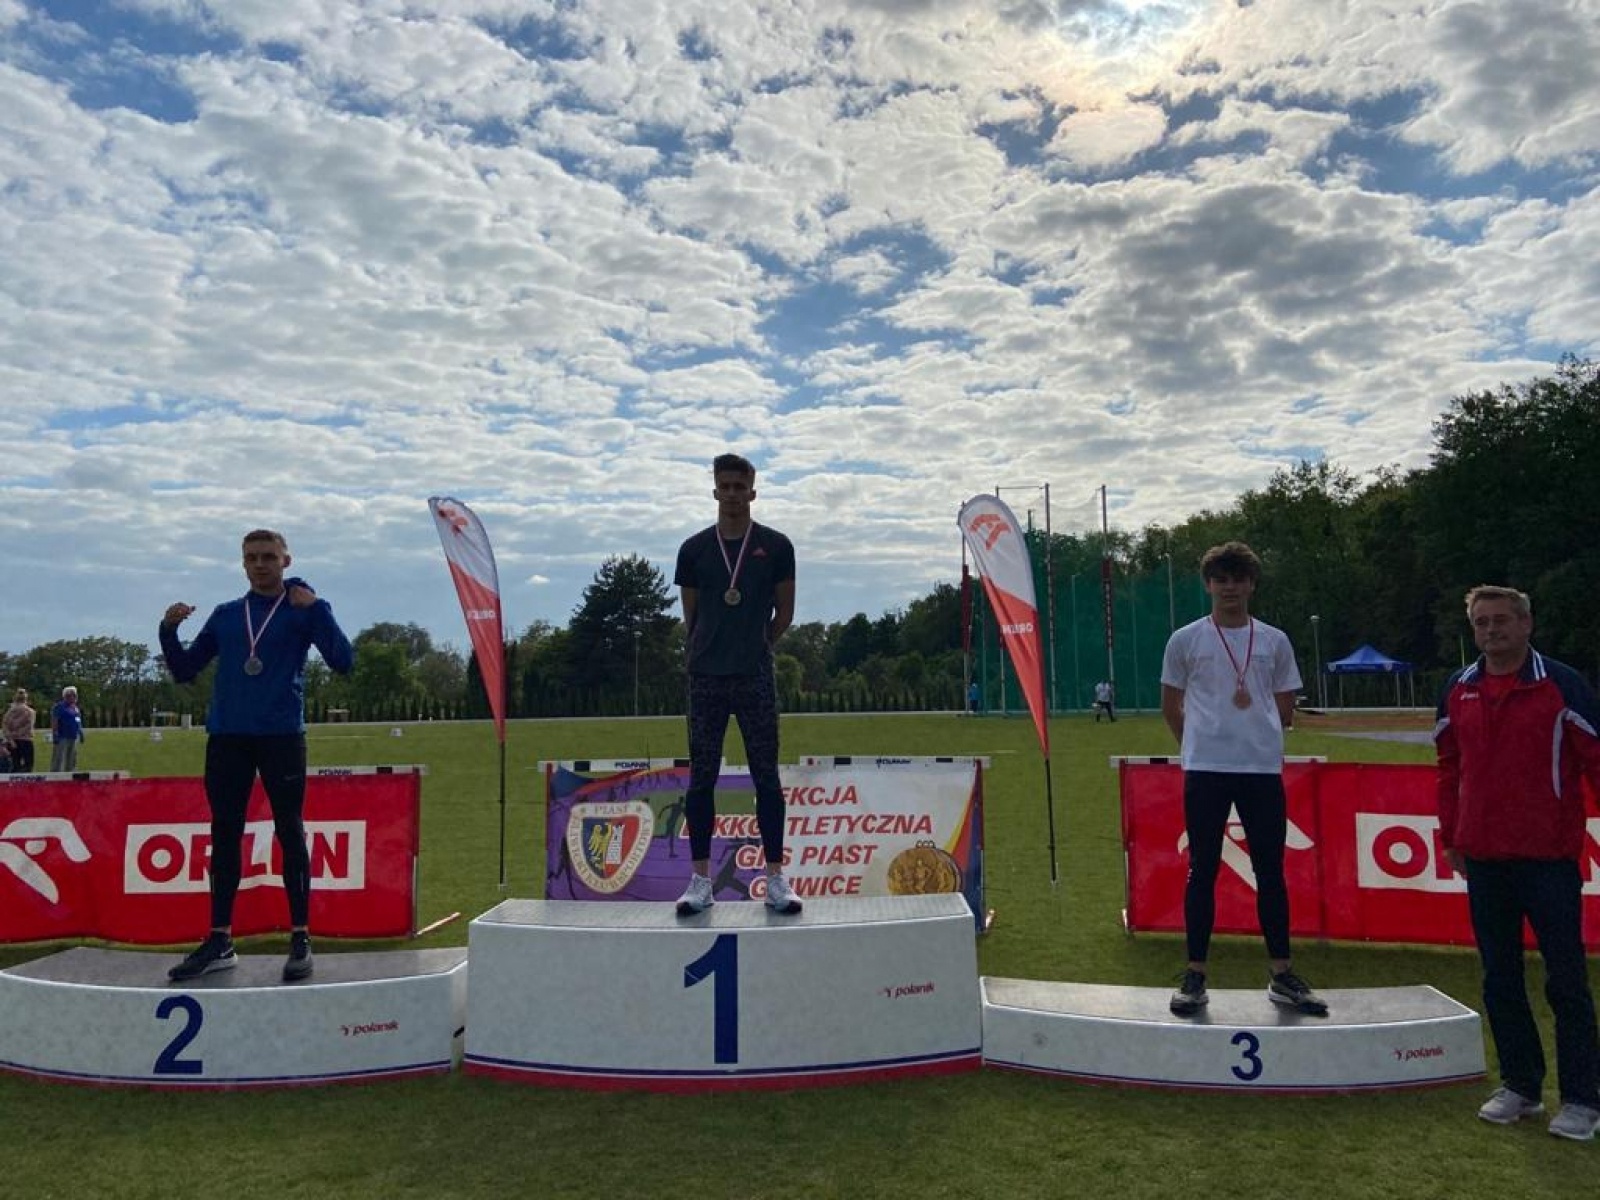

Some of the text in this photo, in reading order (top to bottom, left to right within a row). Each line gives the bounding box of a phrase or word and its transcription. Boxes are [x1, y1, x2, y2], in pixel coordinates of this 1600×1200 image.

[800, 844, 878, 866] PIAST
[683, 933, 739, 1065] 1
[153, 995, 204, 1075] 2
[1230, 1031, 1263, 1081] 3
